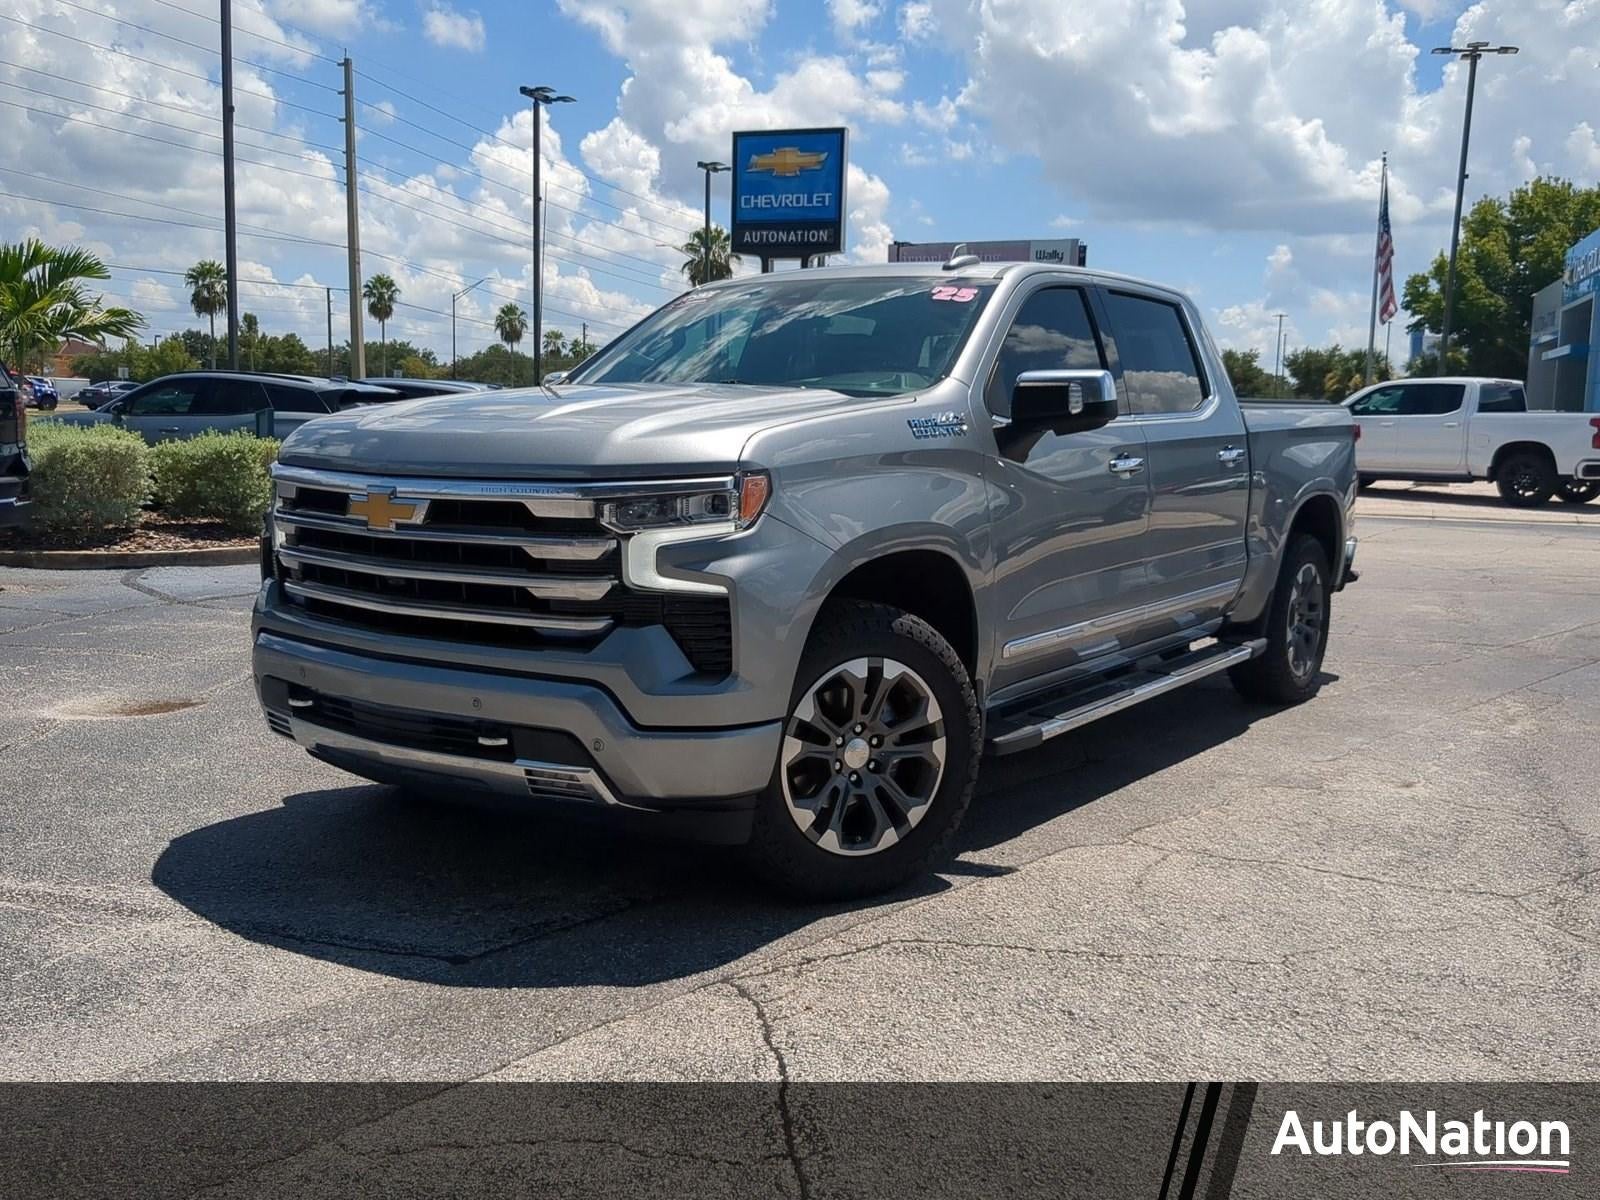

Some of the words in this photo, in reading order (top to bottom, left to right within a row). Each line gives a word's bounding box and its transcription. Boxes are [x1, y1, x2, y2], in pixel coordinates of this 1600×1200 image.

[741, 193, 832, 208] CHEVROLET
[743, 229, 829, 243] AUTONATION
[1035, 249, 1064, 263] Wally
[931, 286, 978, 302] 25
